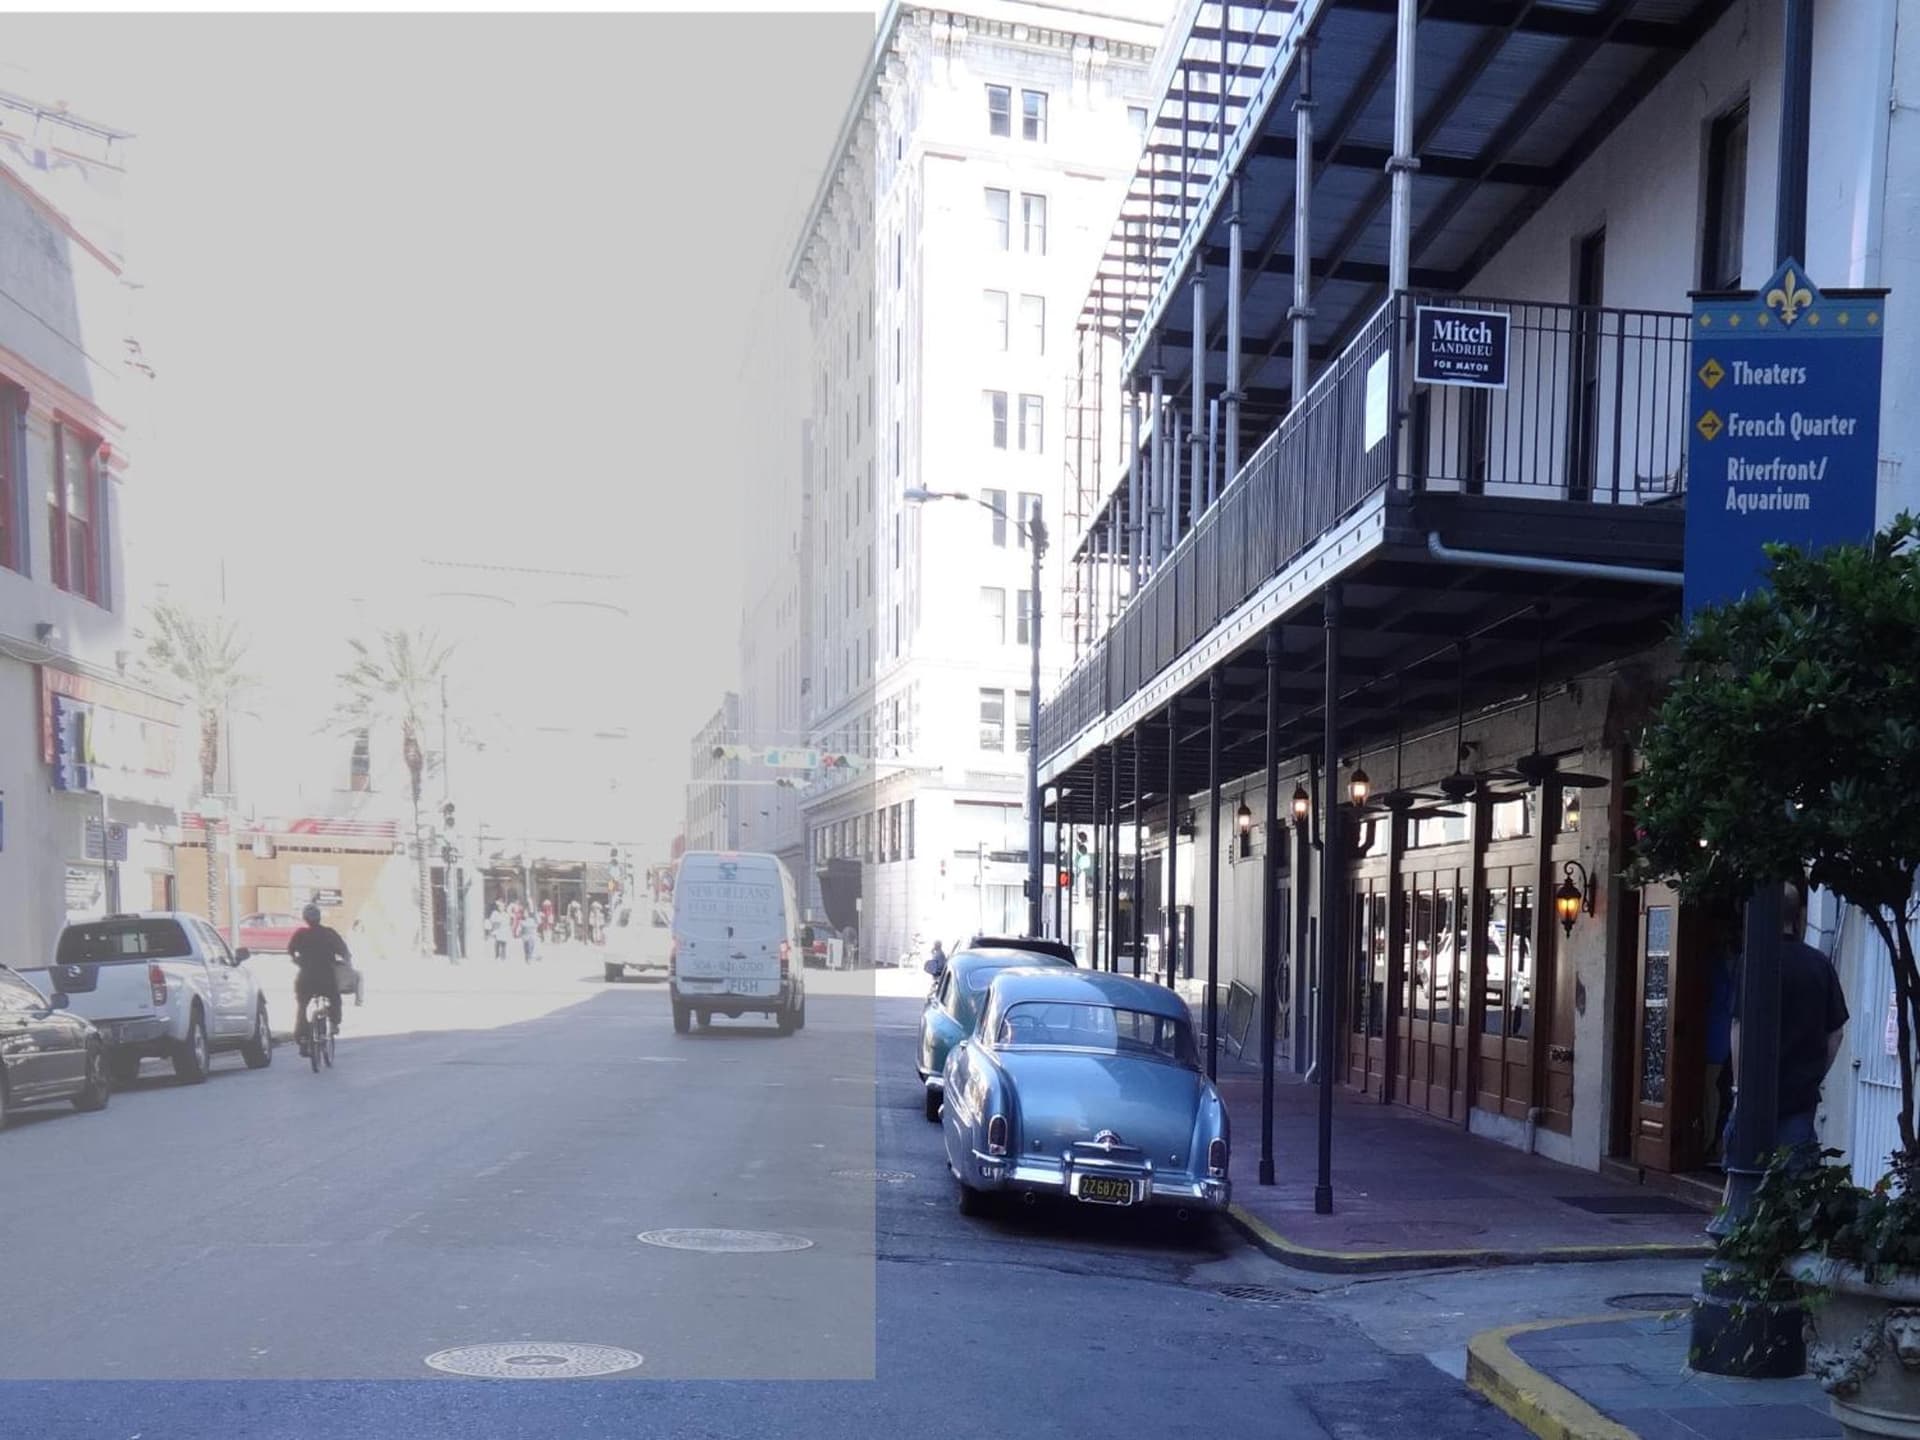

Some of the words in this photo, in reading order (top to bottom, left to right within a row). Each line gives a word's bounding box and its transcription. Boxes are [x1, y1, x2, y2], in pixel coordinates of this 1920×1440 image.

[1433, 320, 1492, 344] Mitch
[1432, 342, 1492, 356] LANDRIEU
[1434, 360, 1452, 369] FOR
[1456, 362, 1488, 371] MAYOR
[1732, 361, 1807, 385] Theaters
[1728, 412, 1786, 437] French
[1790, 411, 1857, 441] Quarter
[1727, 456, 1829, 481] Riverfront/
[1726, 486, 1810, 515] Aquarium
[688, 886, 712, 897] NEW
[716, 887, 771, 900] ORLEANS
[730, 978, 758, 992] FISH
